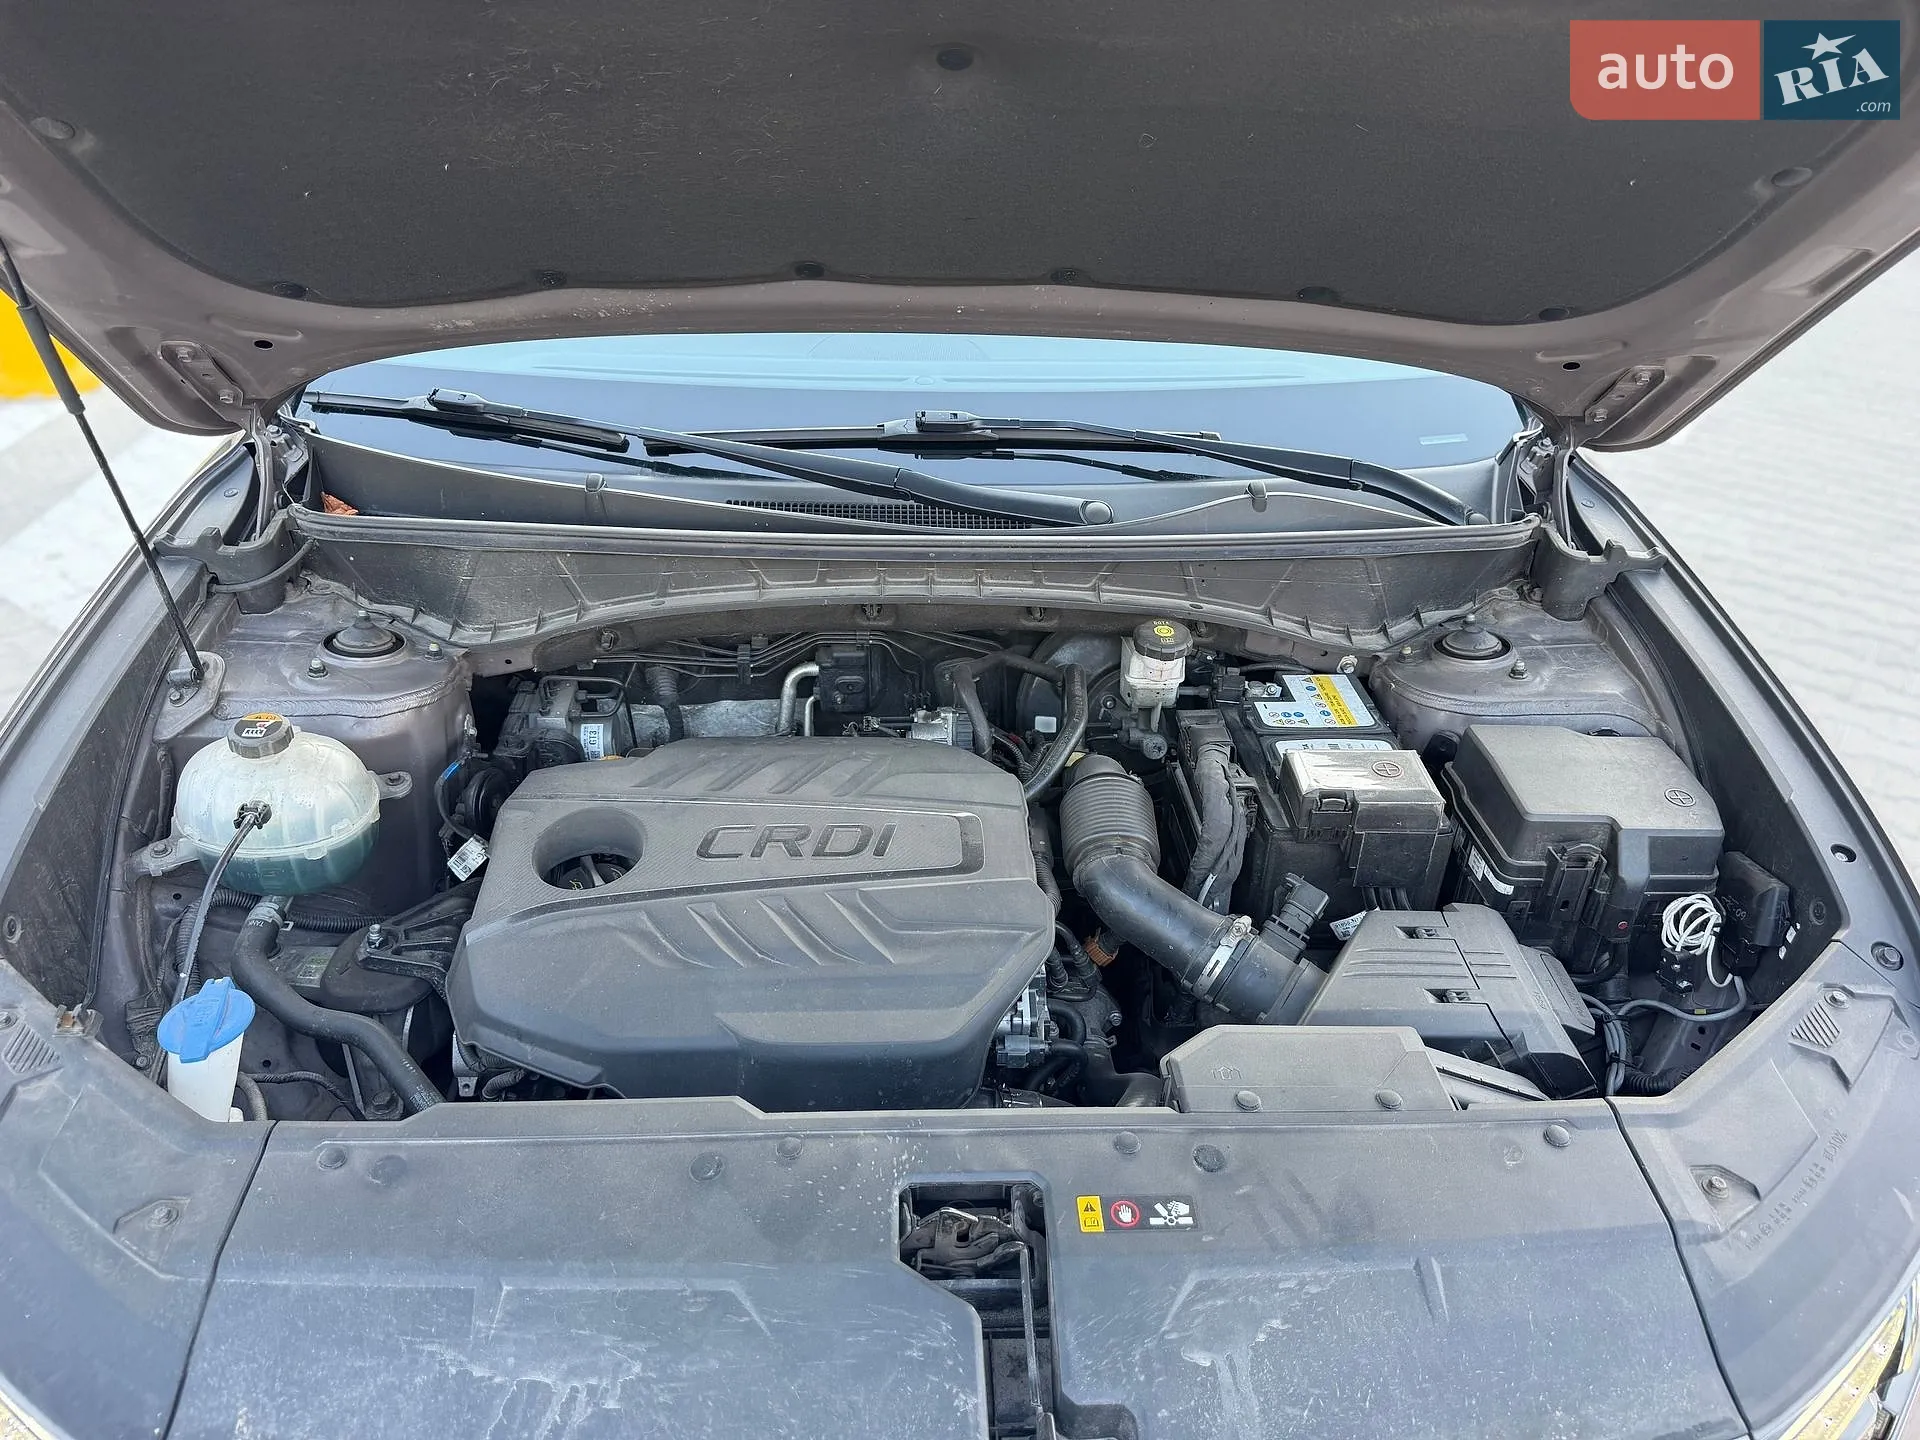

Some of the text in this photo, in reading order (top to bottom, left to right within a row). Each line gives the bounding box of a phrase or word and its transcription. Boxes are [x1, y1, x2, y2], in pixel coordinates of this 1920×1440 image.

[588, 730, 598, 746] GT3
[696, 822, 898, 861] CRDI
[248, 920, 264, 928] TANK
